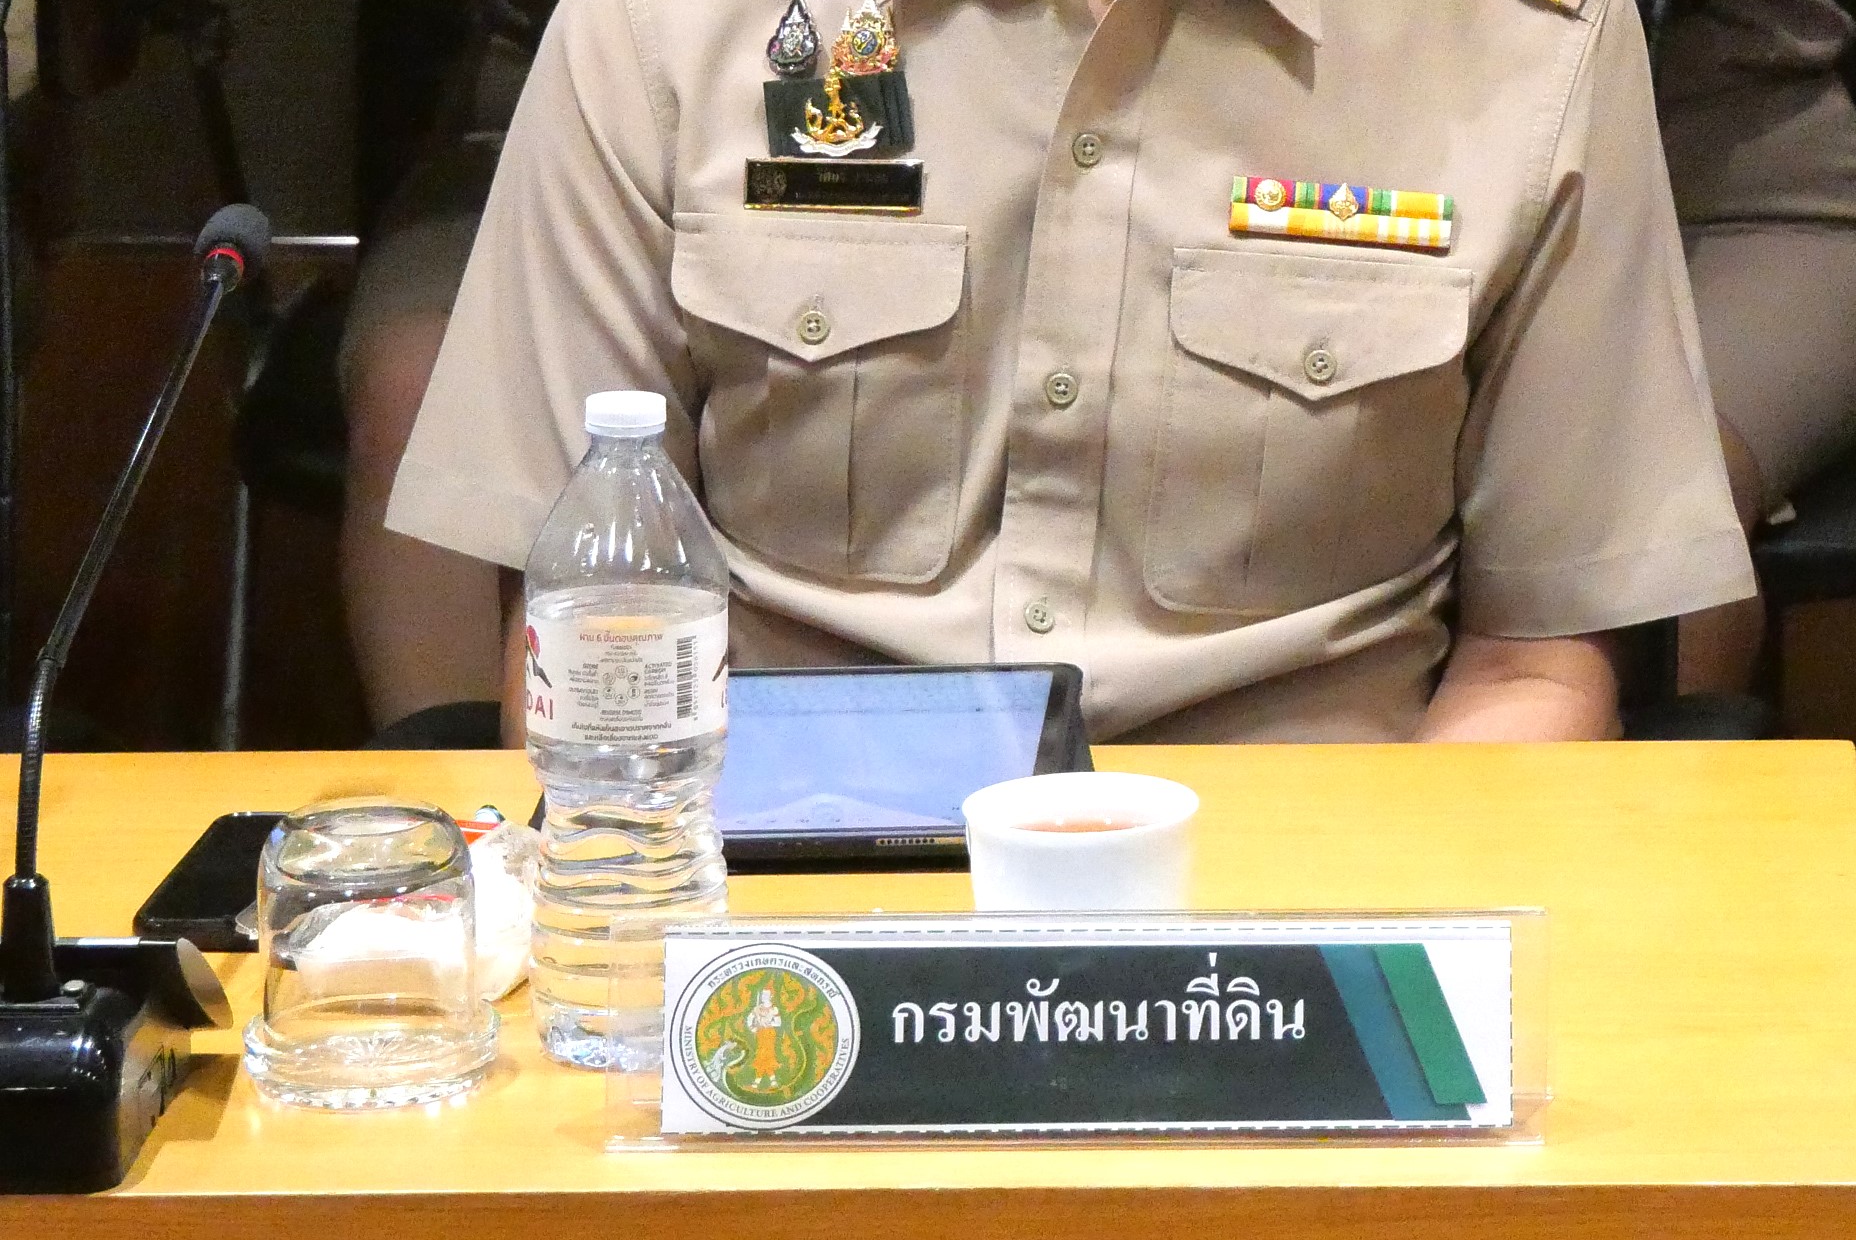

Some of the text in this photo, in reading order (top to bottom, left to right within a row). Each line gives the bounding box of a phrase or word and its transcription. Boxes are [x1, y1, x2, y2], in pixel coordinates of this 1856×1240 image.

[892, 953, 1306, 1043] กรมพัฒนาที่ดิน
[683, 1025, 850, 1119] MINISTRY OF AGRICULTURE AND COOPERATIVES
